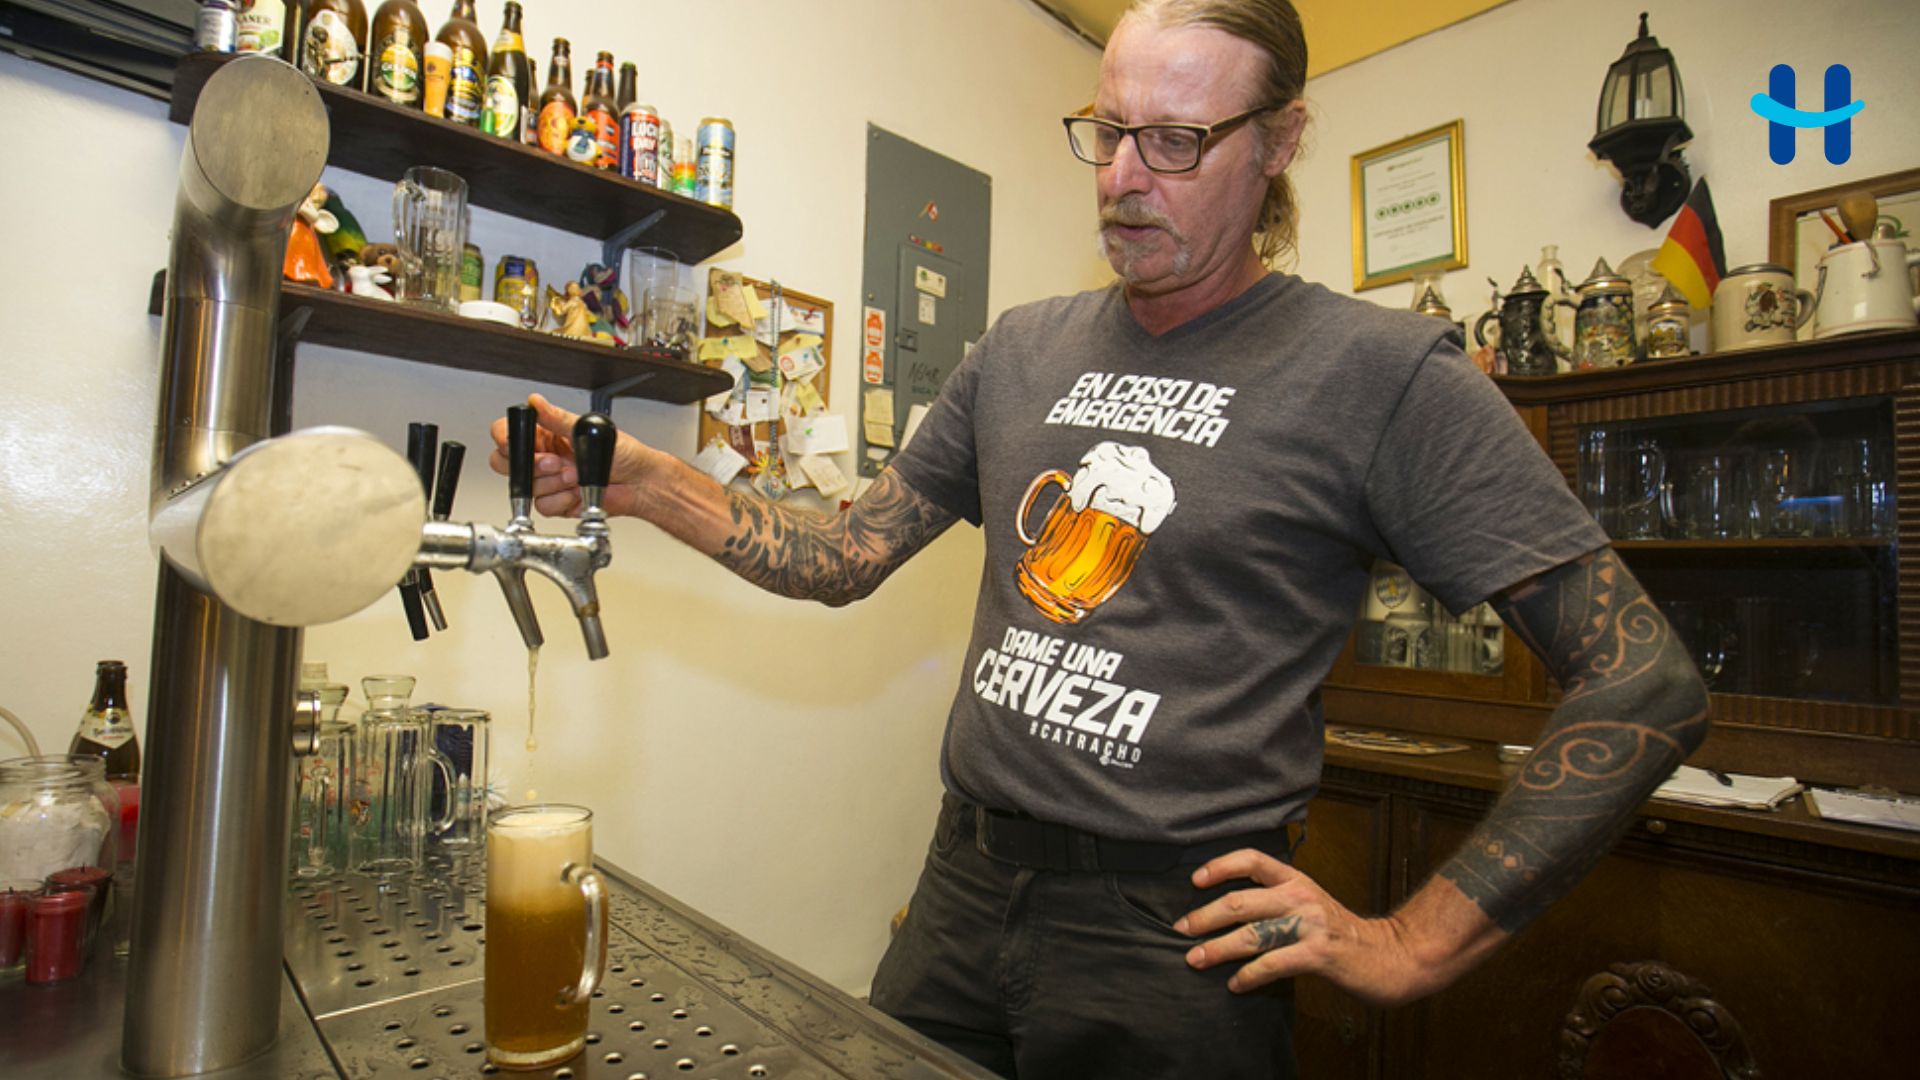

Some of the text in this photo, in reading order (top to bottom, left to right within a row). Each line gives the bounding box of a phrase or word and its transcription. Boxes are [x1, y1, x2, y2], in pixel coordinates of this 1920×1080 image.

[1069, 372, 1236, 416] EN CASO DE
[1044, 398, 1230, 448] EMERGENCIA
[1000, 626, 1124, 680] DAME UNA
[973, 647, 1162, 744] CERVEZA
